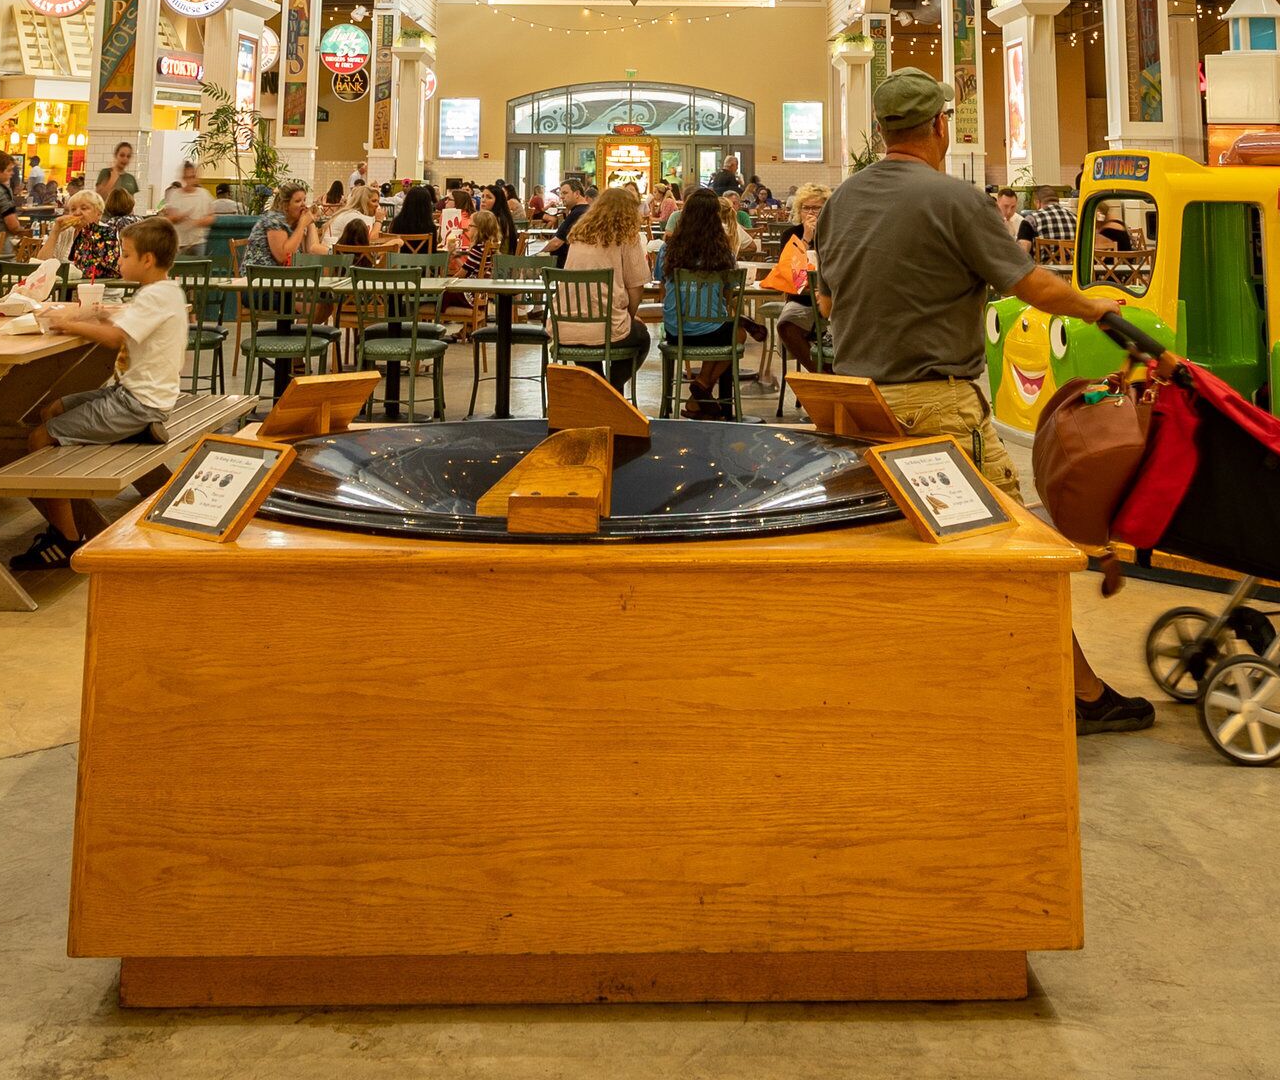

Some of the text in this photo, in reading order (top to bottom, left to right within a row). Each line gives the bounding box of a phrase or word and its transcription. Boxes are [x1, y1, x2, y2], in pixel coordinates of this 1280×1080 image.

[336, 41, 361, 57] 55
[168, 59, 197, 77] TOKYO
[336, 82, 363, 91] BANK
